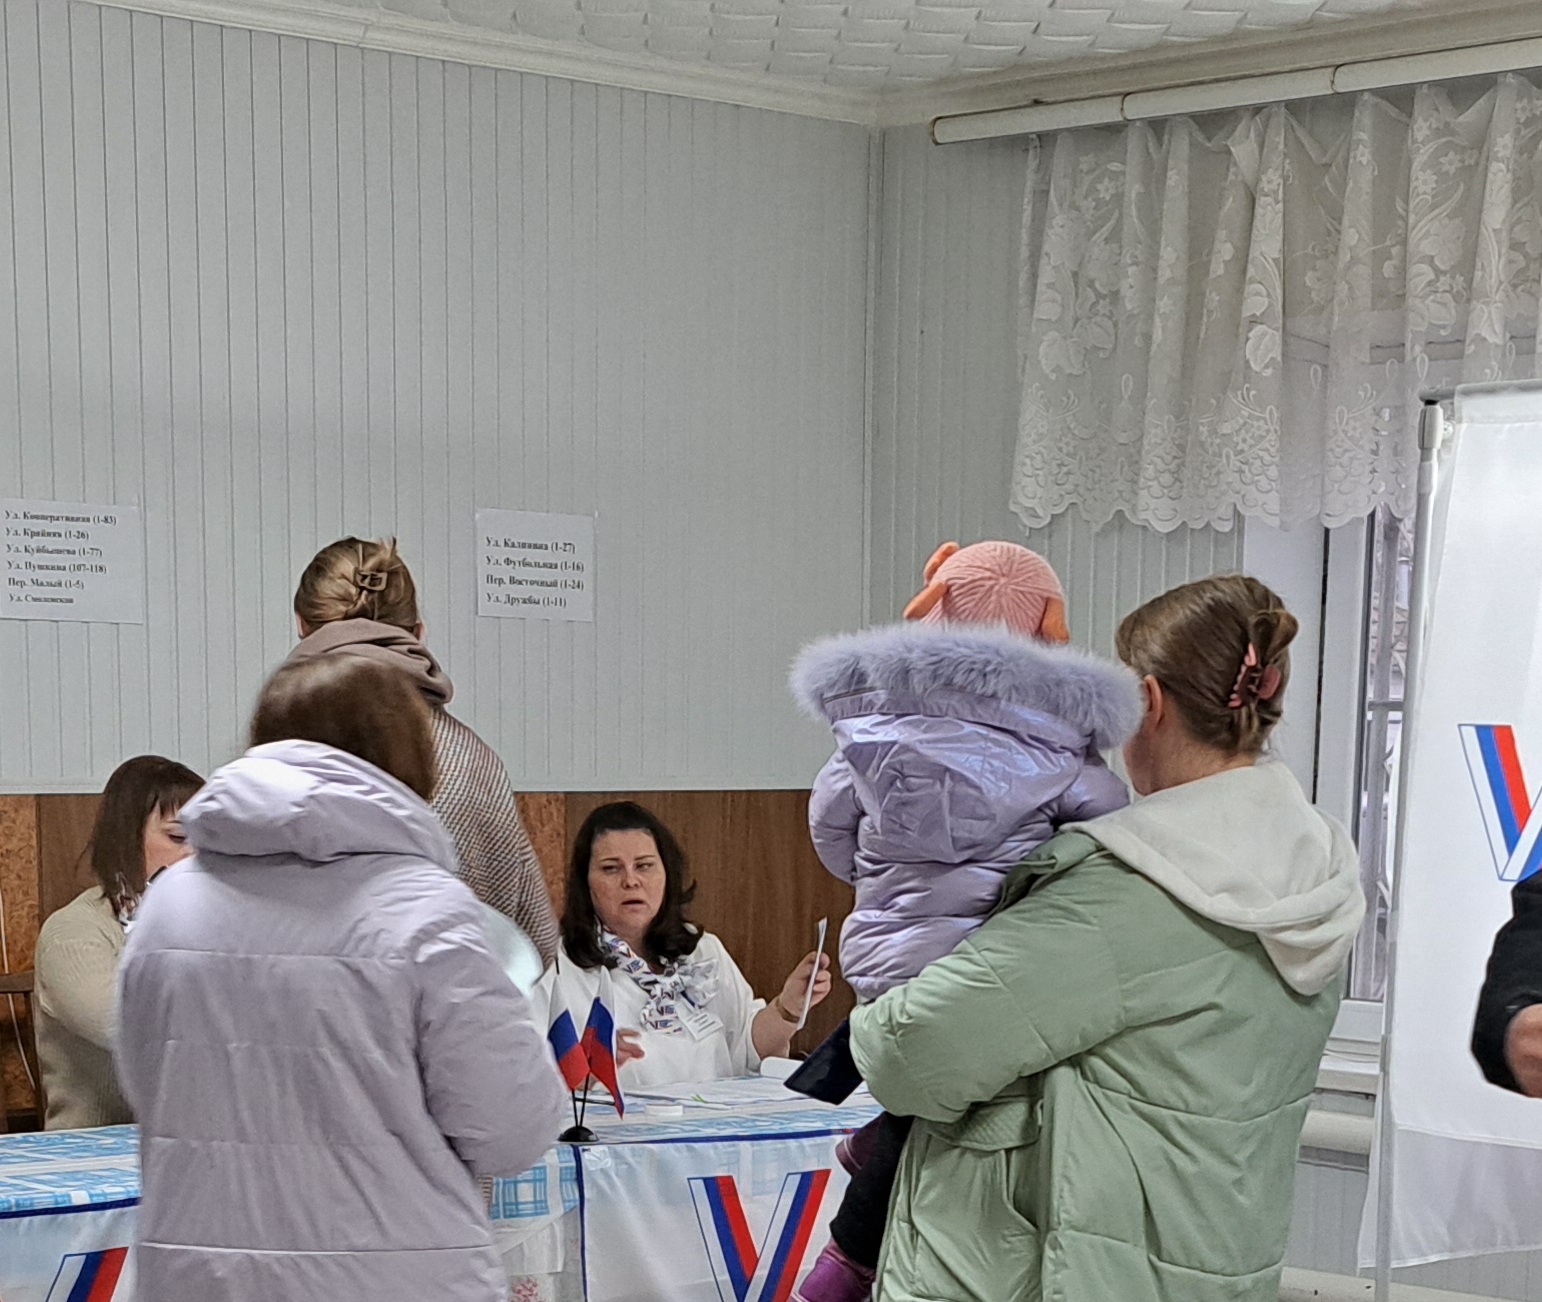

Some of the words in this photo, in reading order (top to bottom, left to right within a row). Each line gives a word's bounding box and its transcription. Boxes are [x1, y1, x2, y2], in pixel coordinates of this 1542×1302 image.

[5, 510, 21, 519] Ул.
[6, 527, 21, 536] Ул.
[486, 537, 501, 547] Ул.
[7, 544, 22, 553] Ул.
[7, 561, 22, 570] Ул.
[486, 556, 501, 566] Ул.
[8, 578, 28, 588] Пер.
[486, 574, 506, 587] Пер.
[487, 593, 501, 602] Ул.
